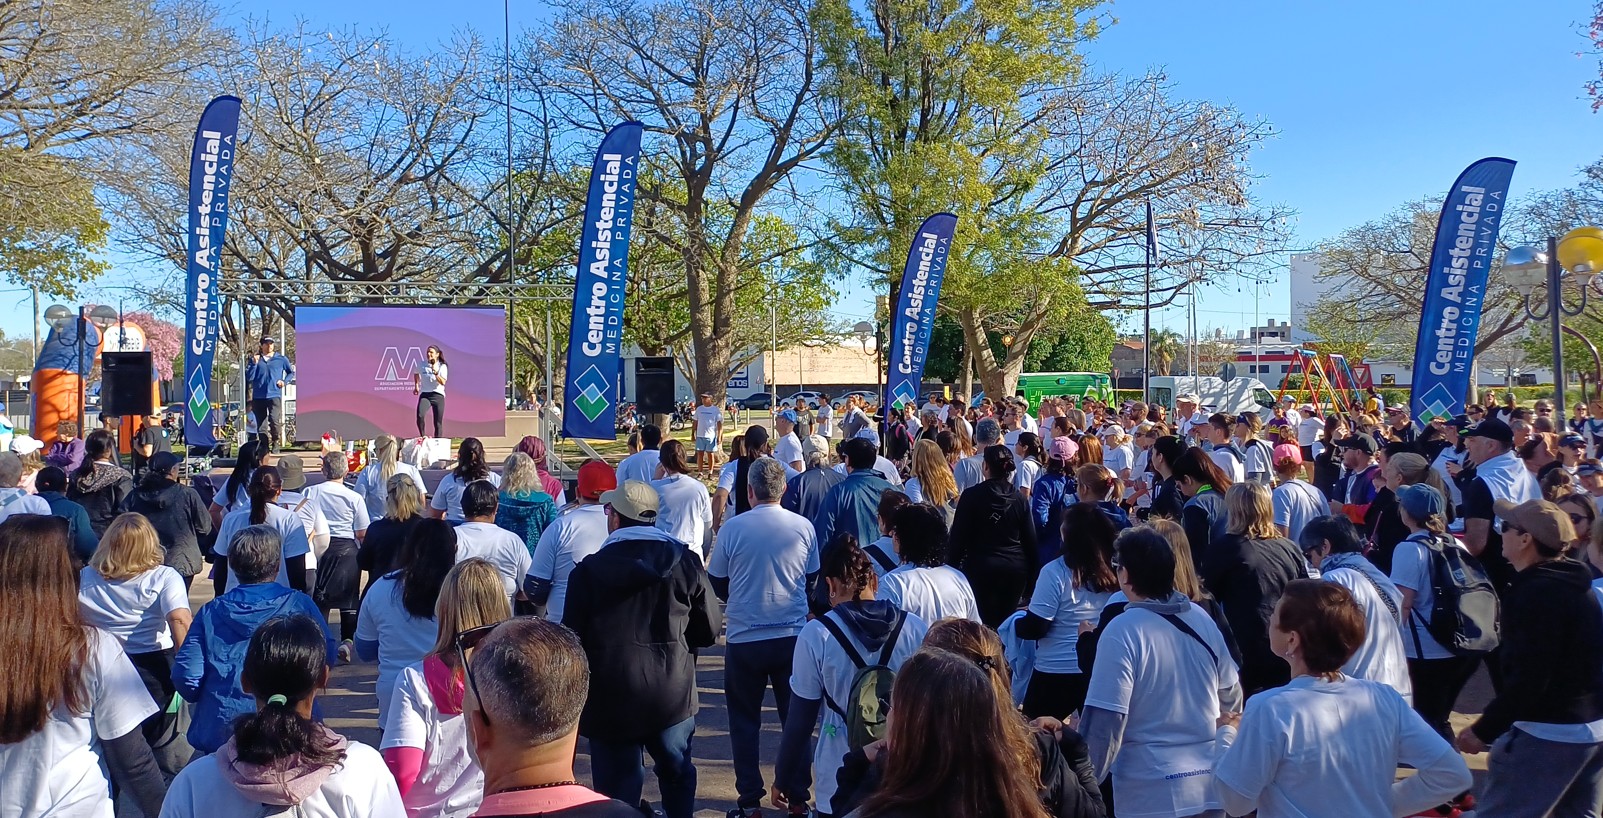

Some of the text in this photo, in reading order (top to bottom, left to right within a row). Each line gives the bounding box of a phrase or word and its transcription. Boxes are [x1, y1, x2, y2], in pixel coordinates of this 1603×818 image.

[192, 131, 222, 356] Centro Asistencial
[205, 135, 233, 351] MEDICINA PRIVADA
[582, 153, 622, 357] Centro Asistencial
[606, 155, 634, 354] MEDICINA PRIVADA
[898, 232, 939, 374] Centro Asistencial
[912, 237, 948, 373] MEDICINA PRIVADA
[1429, 185, 1486, 376] Centro Asistencial
[1453, 190, 1502, 372] MEDICINA PRIVADA
[728, 379, 748, 387] enos
[1165, 768, 1212, 780] centroasistenc
